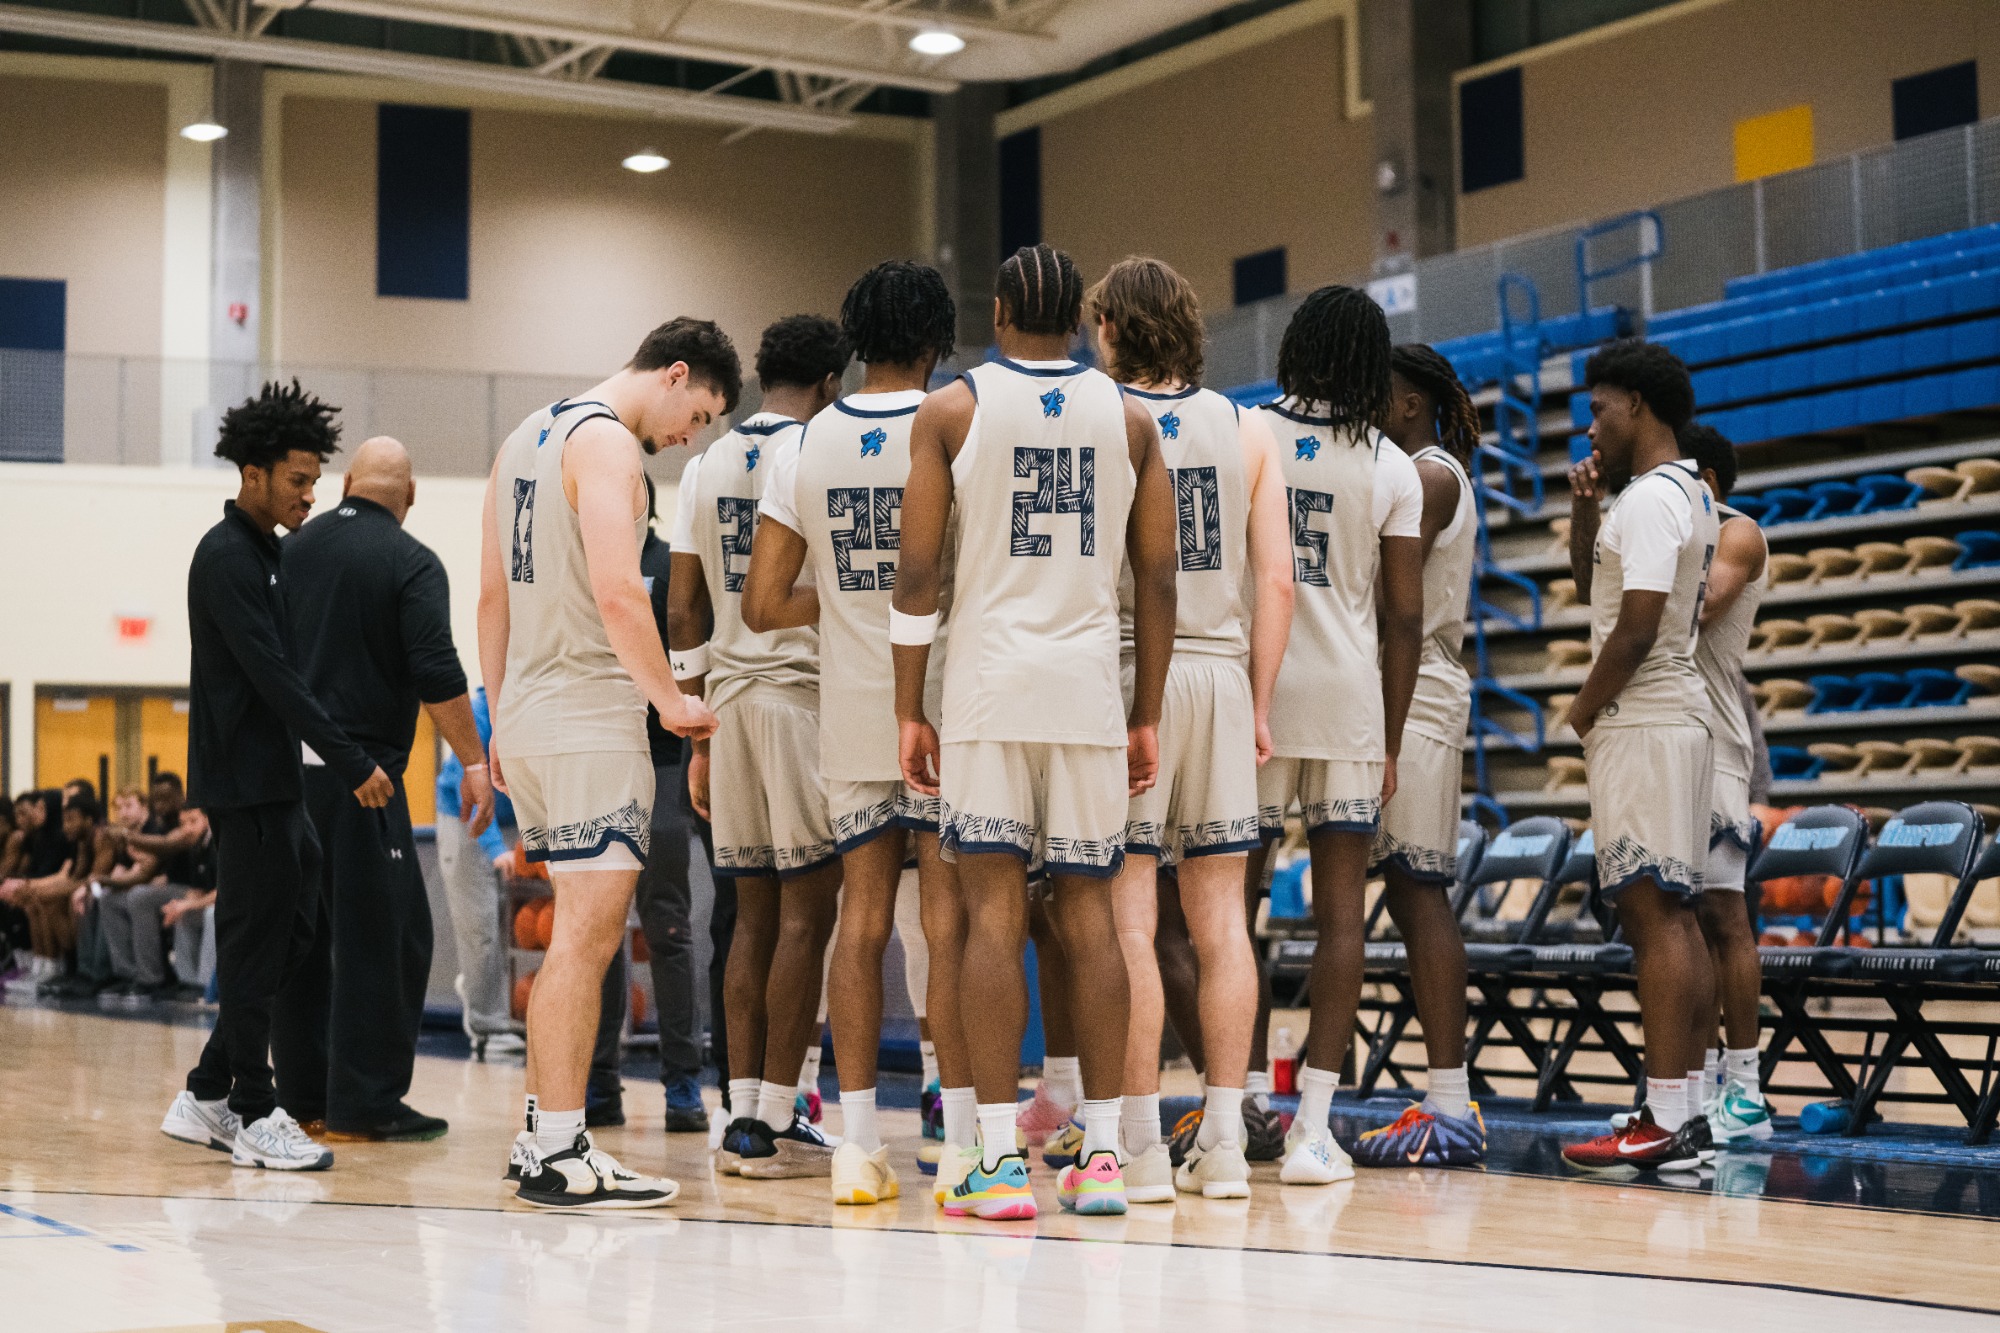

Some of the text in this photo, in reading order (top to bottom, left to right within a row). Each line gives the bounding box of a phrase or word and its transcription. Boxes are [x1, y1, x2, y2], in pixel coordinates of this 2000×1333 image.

[717, 497, 761, 592] 2
[1010, 447, 1095, 556] 24
[1286, 486, 1334, 587] 5
[1861, 956, 1936, 970] FIGHTING OWLS
